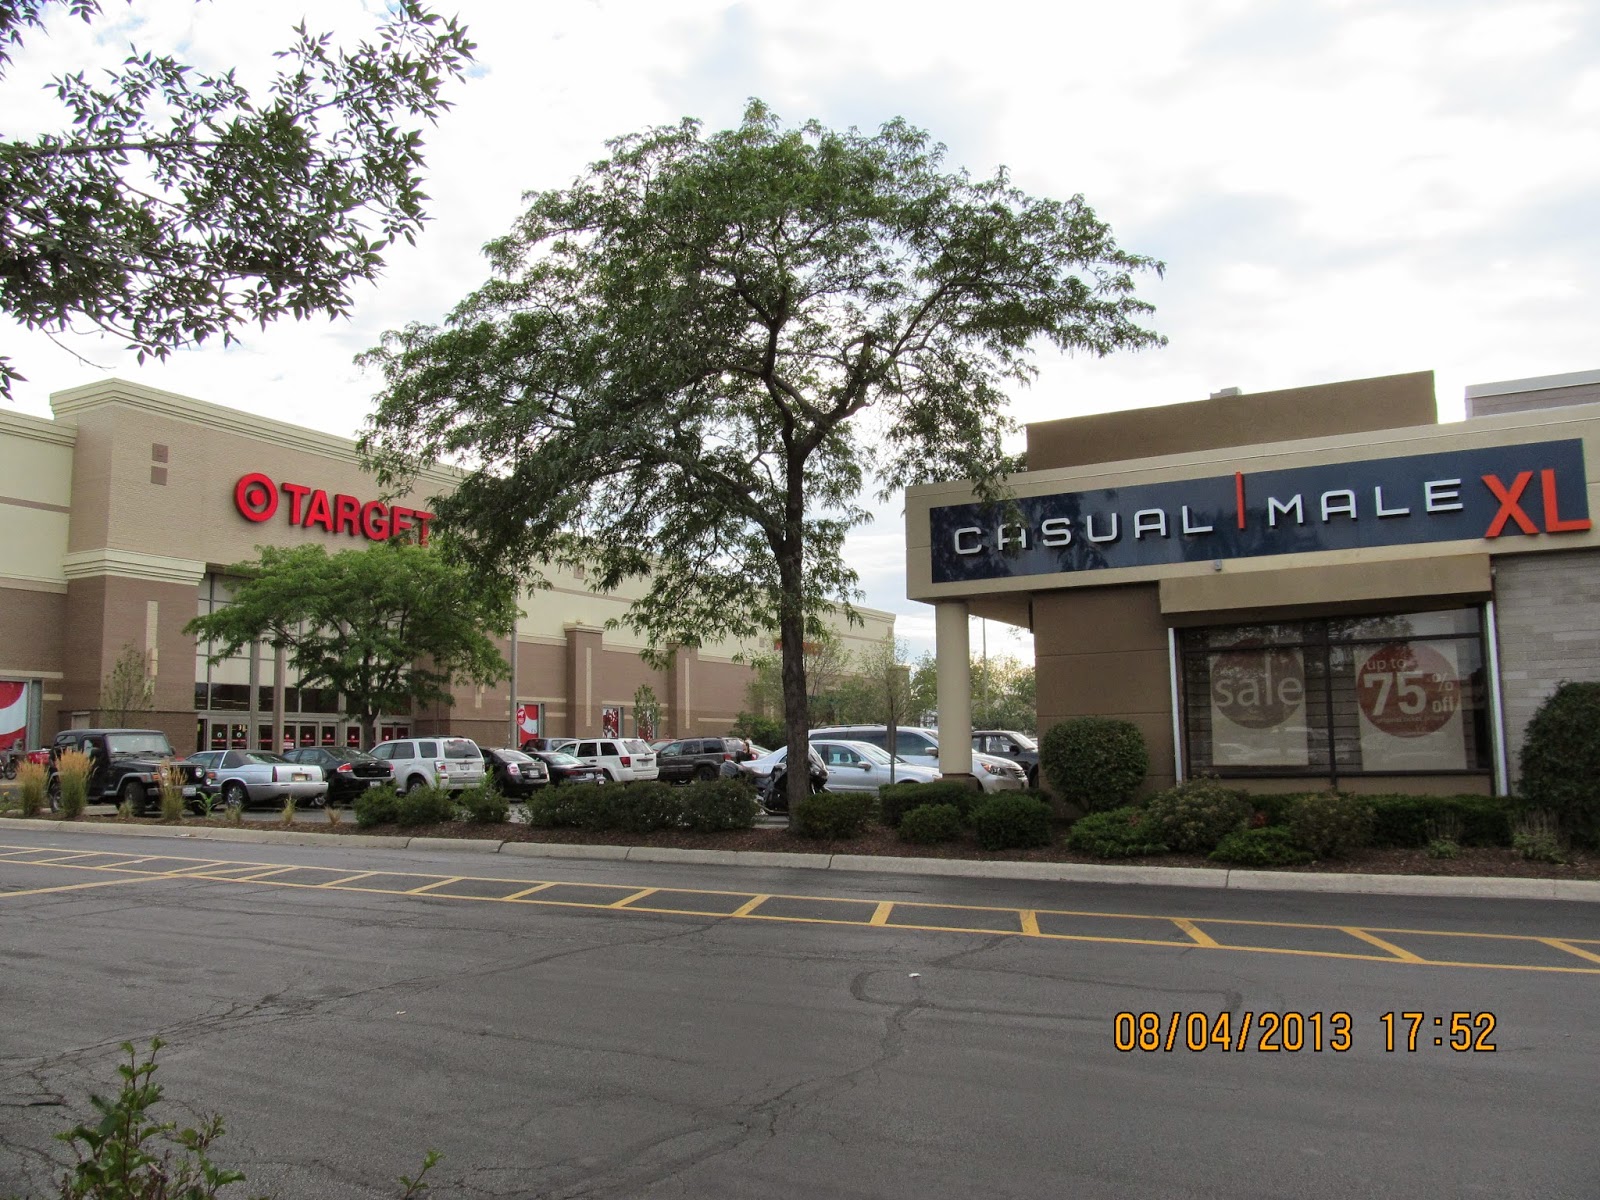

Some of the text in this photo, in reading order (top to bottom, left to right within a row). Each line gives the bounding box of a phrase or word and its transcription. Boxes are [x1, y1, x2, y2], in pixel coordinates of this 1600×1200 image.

[281, 481, 436, 547] TARGET
[953, 468, 1592, 555] CASUAL MALE XL
[1212, 651, 1304, 707] sale
[1366, 658, 1406, 672] up to
[1363, 670, 1454, 716] 75 %
[1432, 694, 1455, 713] off
